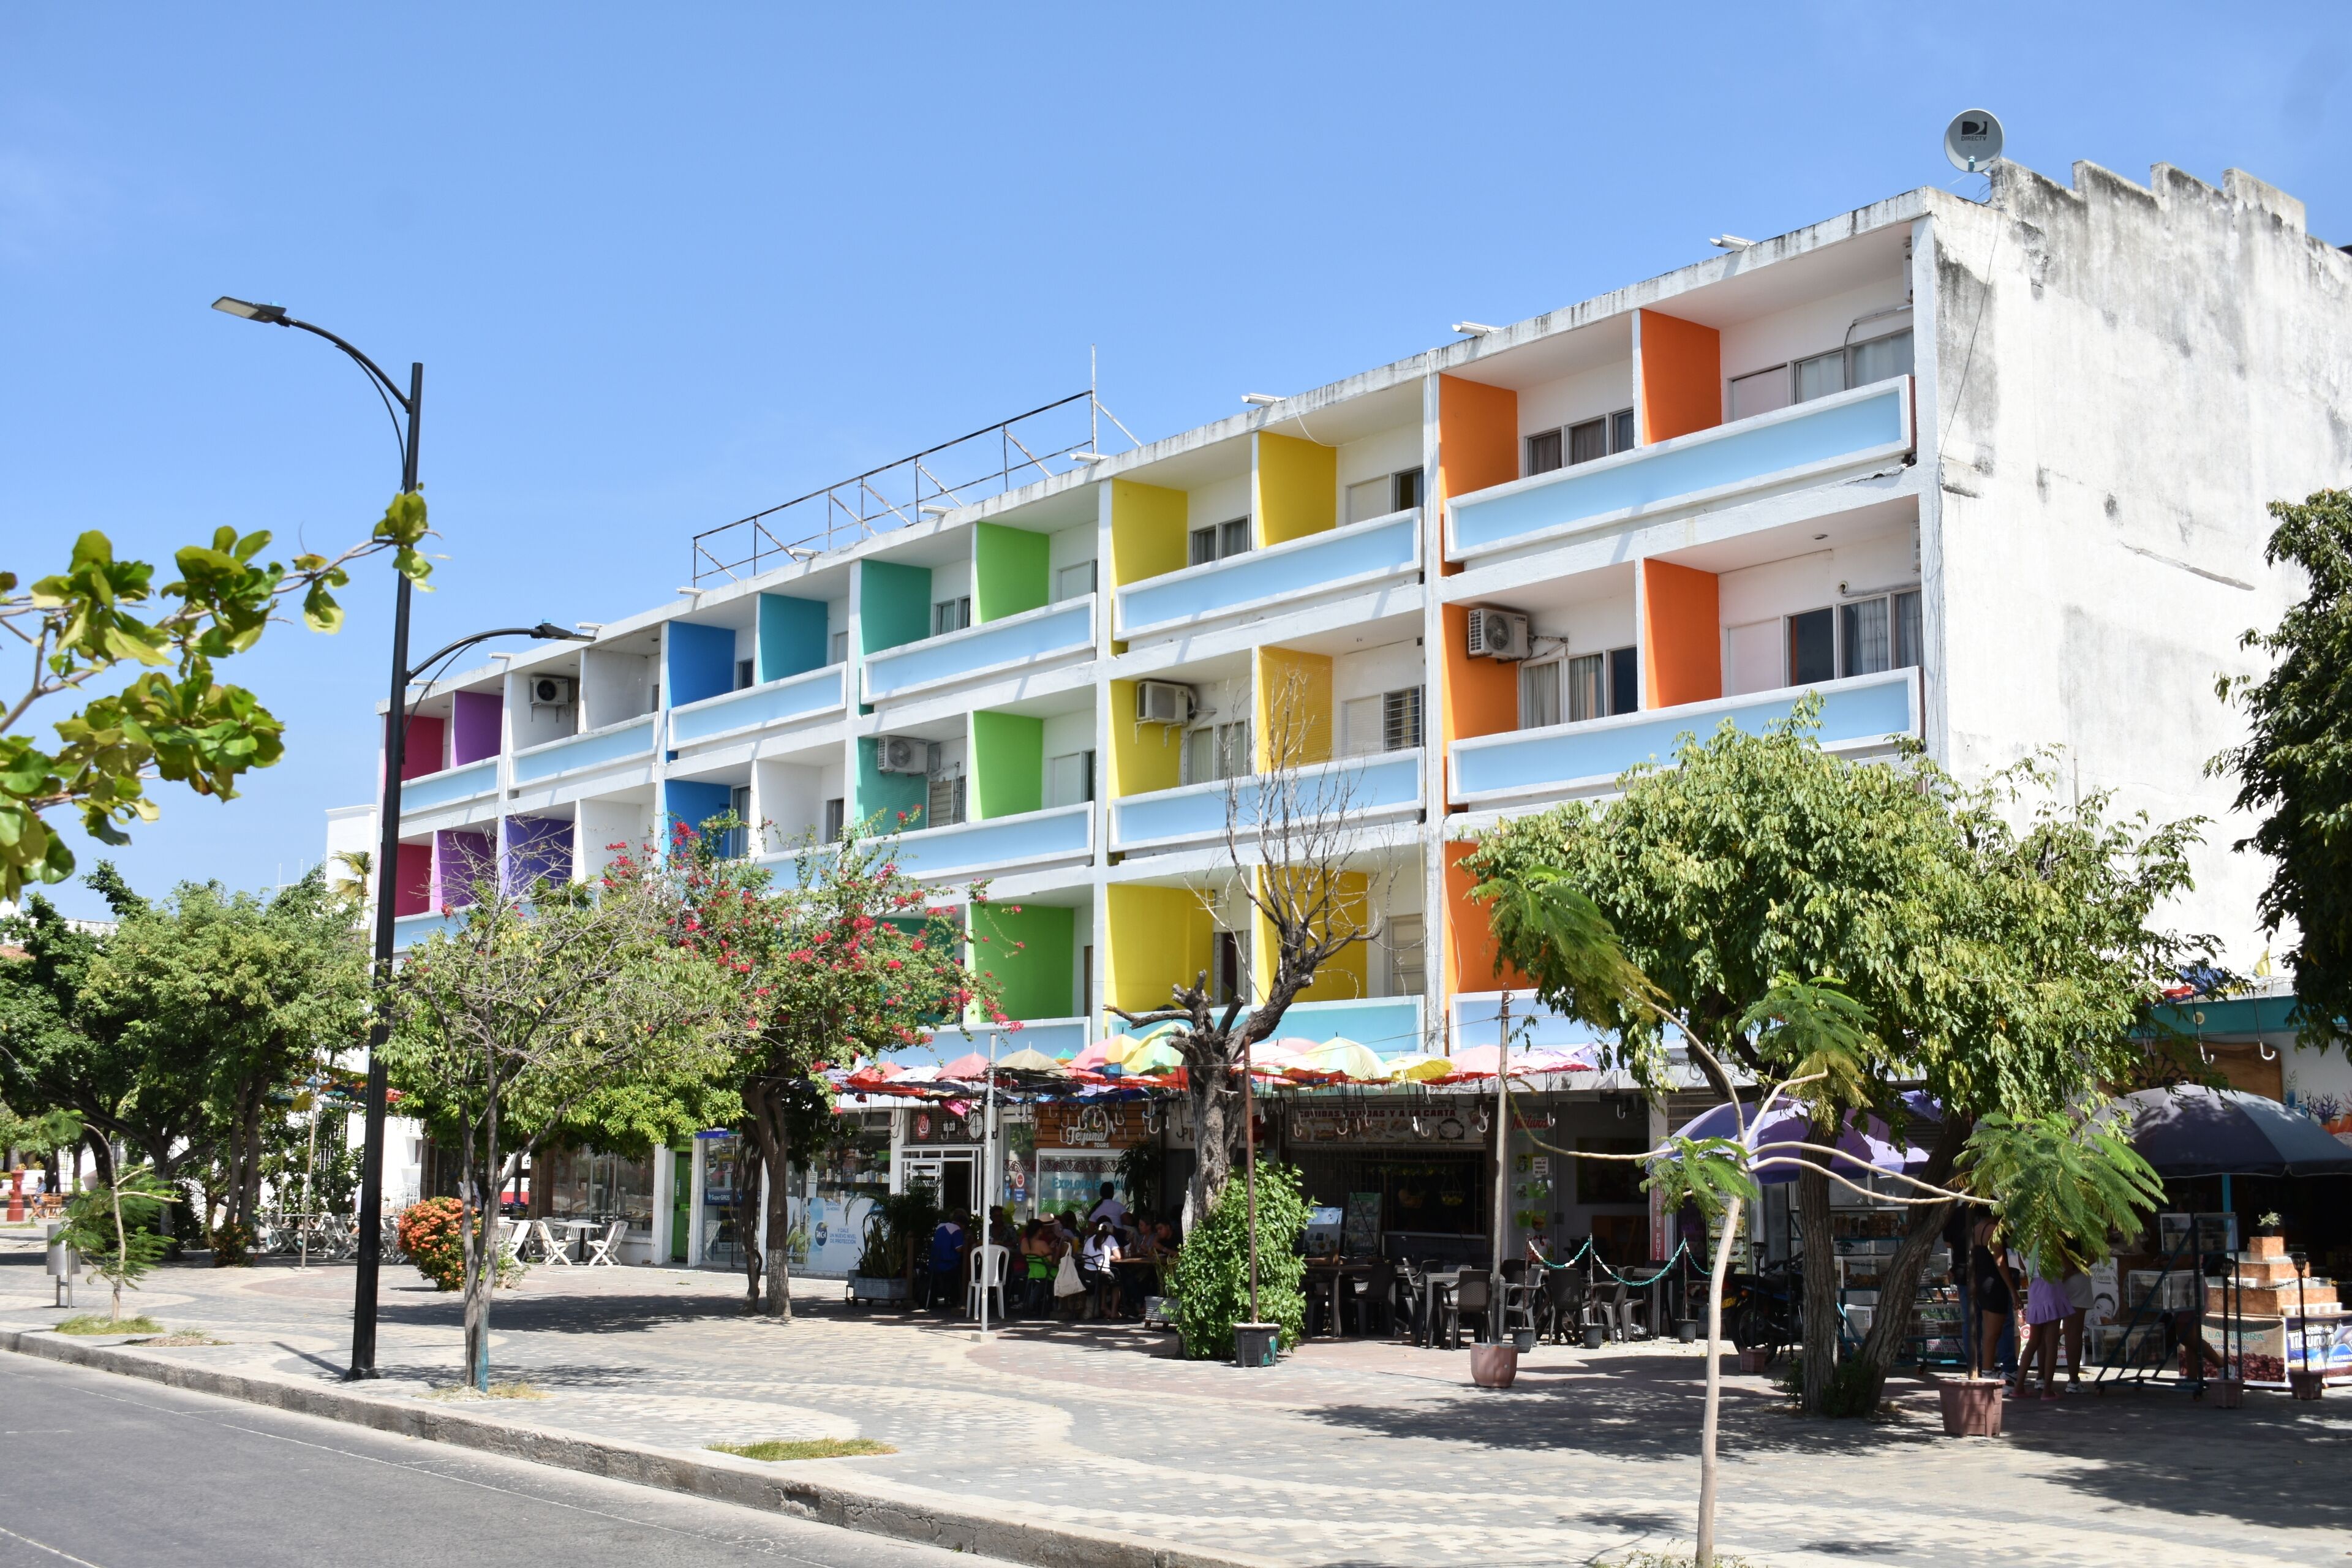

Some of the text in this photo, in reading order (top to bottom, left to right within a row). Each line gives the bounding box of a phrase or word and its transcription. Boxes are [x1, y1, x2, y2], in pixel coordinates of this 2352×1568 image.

[1512, 1112, 1550, 1131] Ntivos
[1656, 1216, 1661, 1227] DE
[2214, 1319, 2272, 1330] OGNICO
